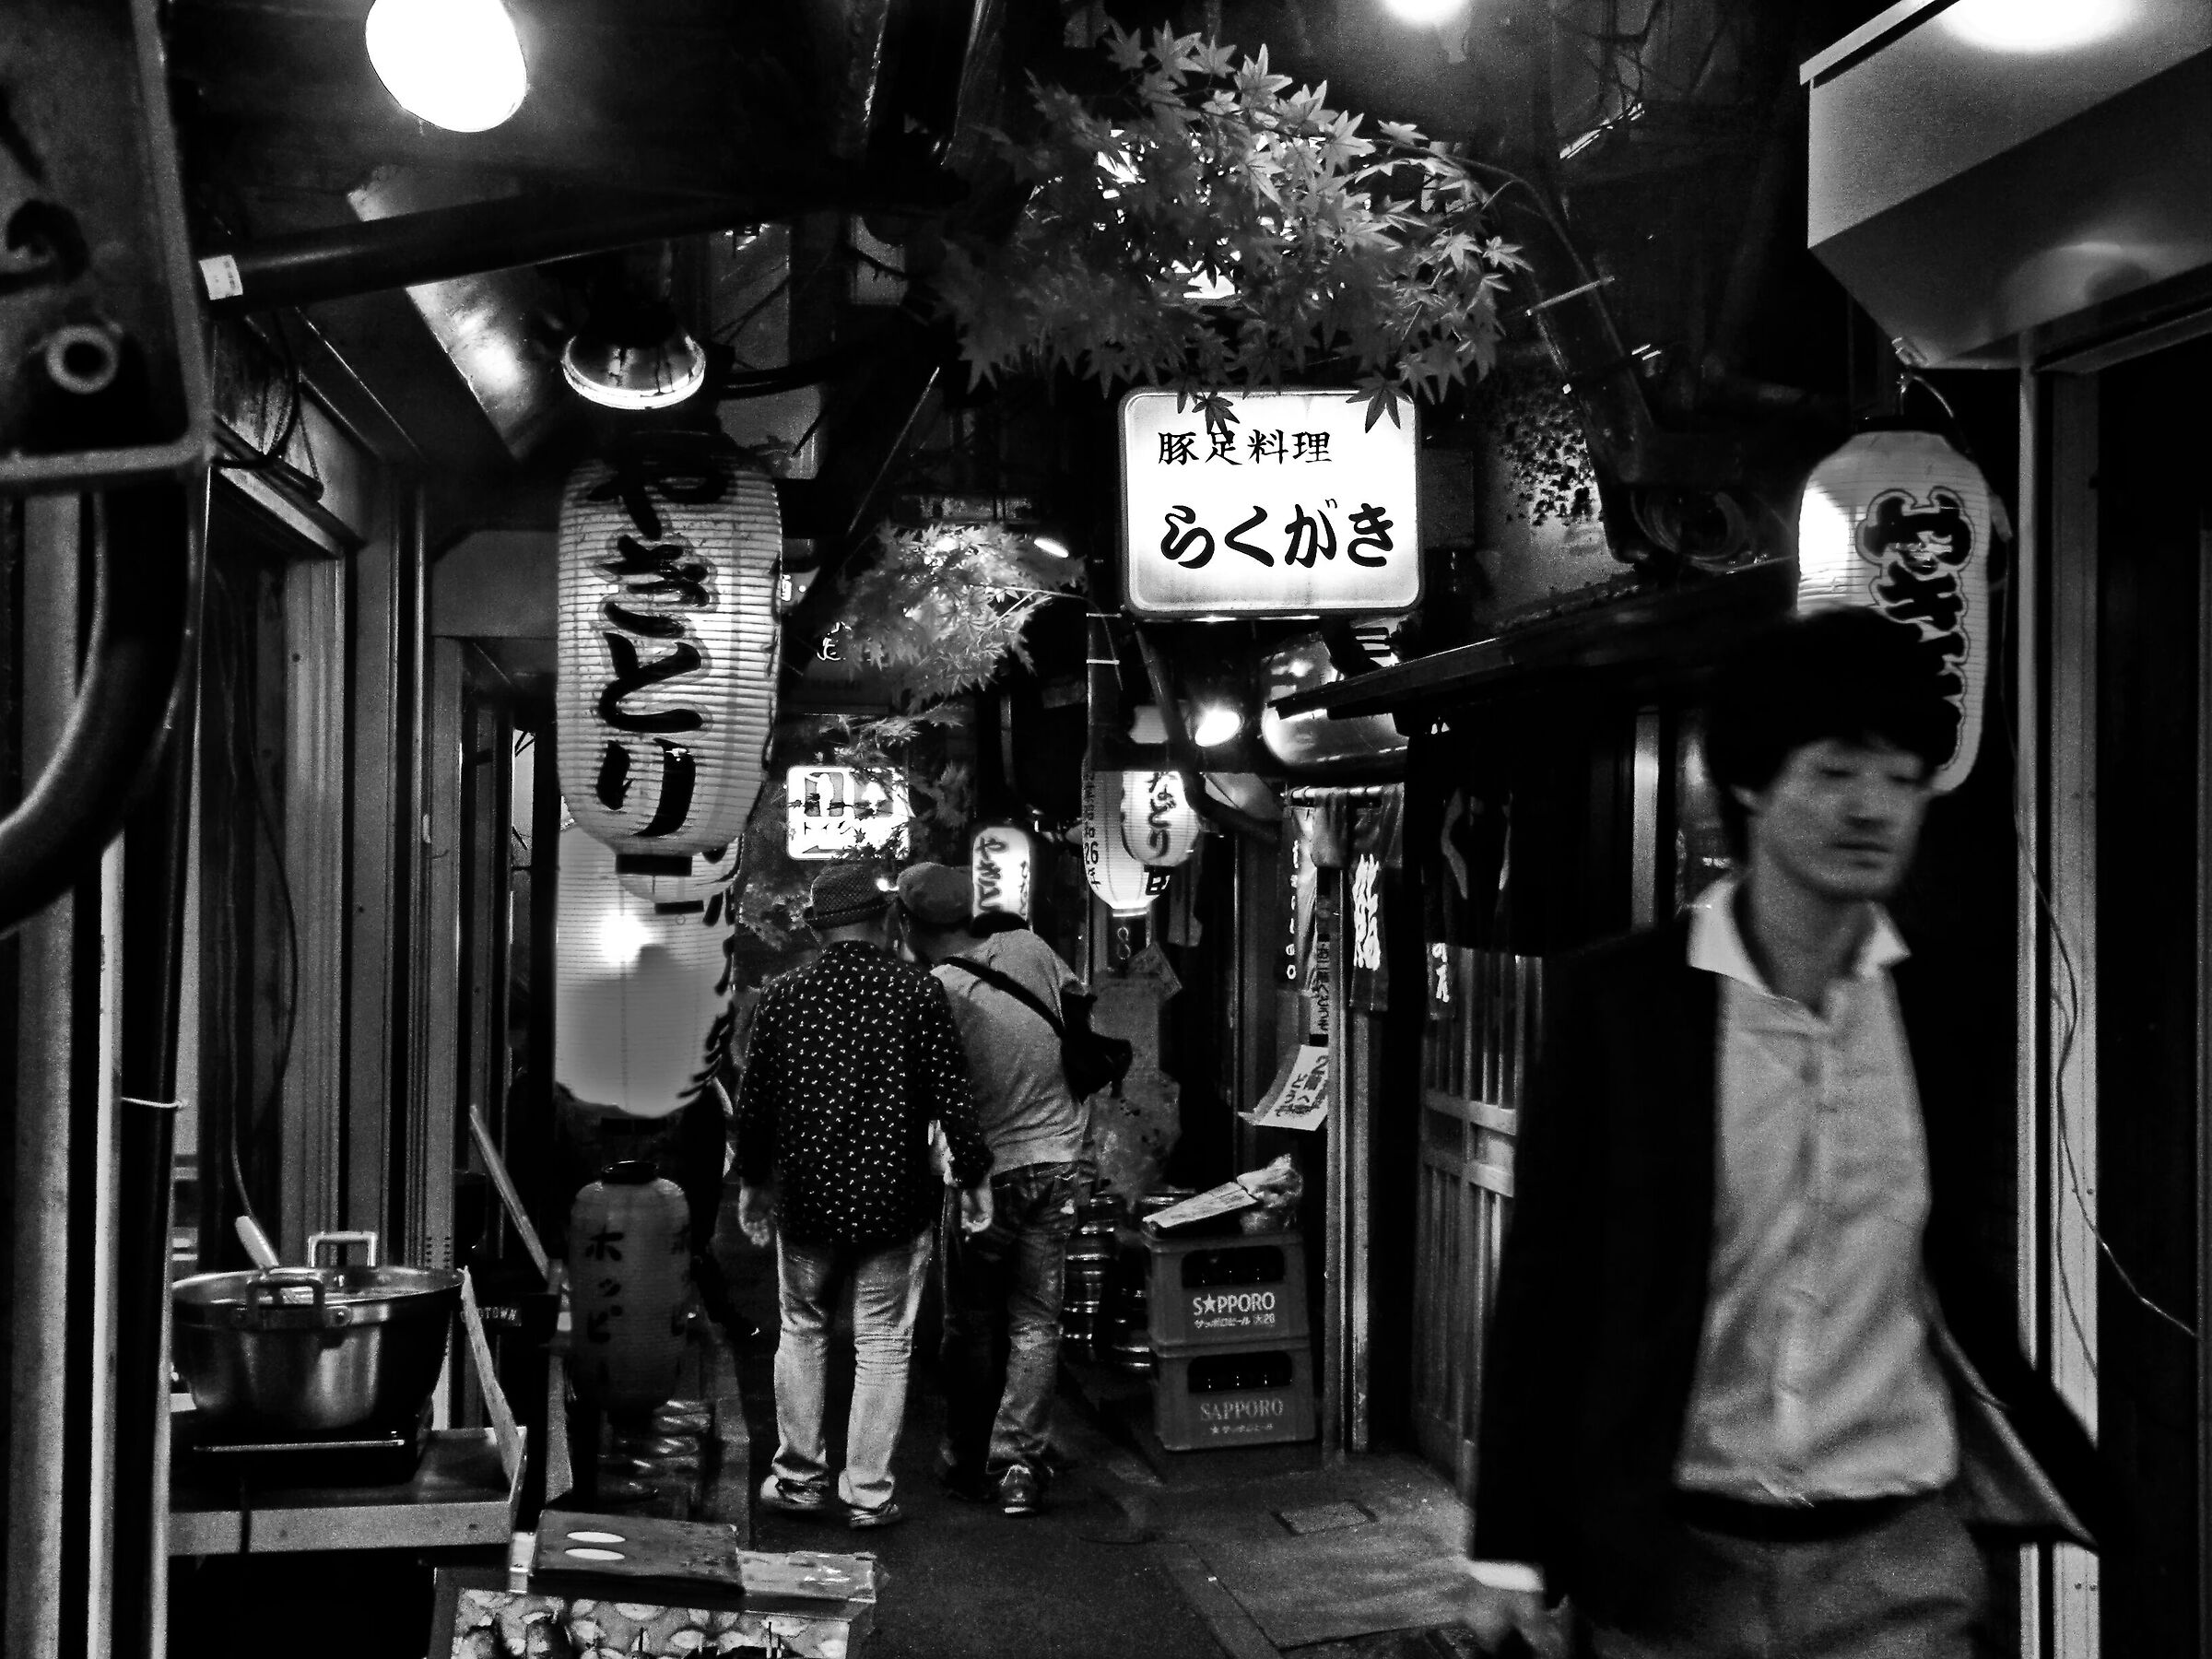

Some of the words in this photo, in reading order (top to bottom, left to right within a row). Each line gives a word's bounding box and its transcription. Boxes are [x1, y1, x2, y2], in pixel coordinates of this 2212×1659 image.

[1159, 428, 1333, 466] 豚足料理
[1159, 498, 1394, 570] らくがき
[1200, 1397, 1284, 1421] SAPPORO
